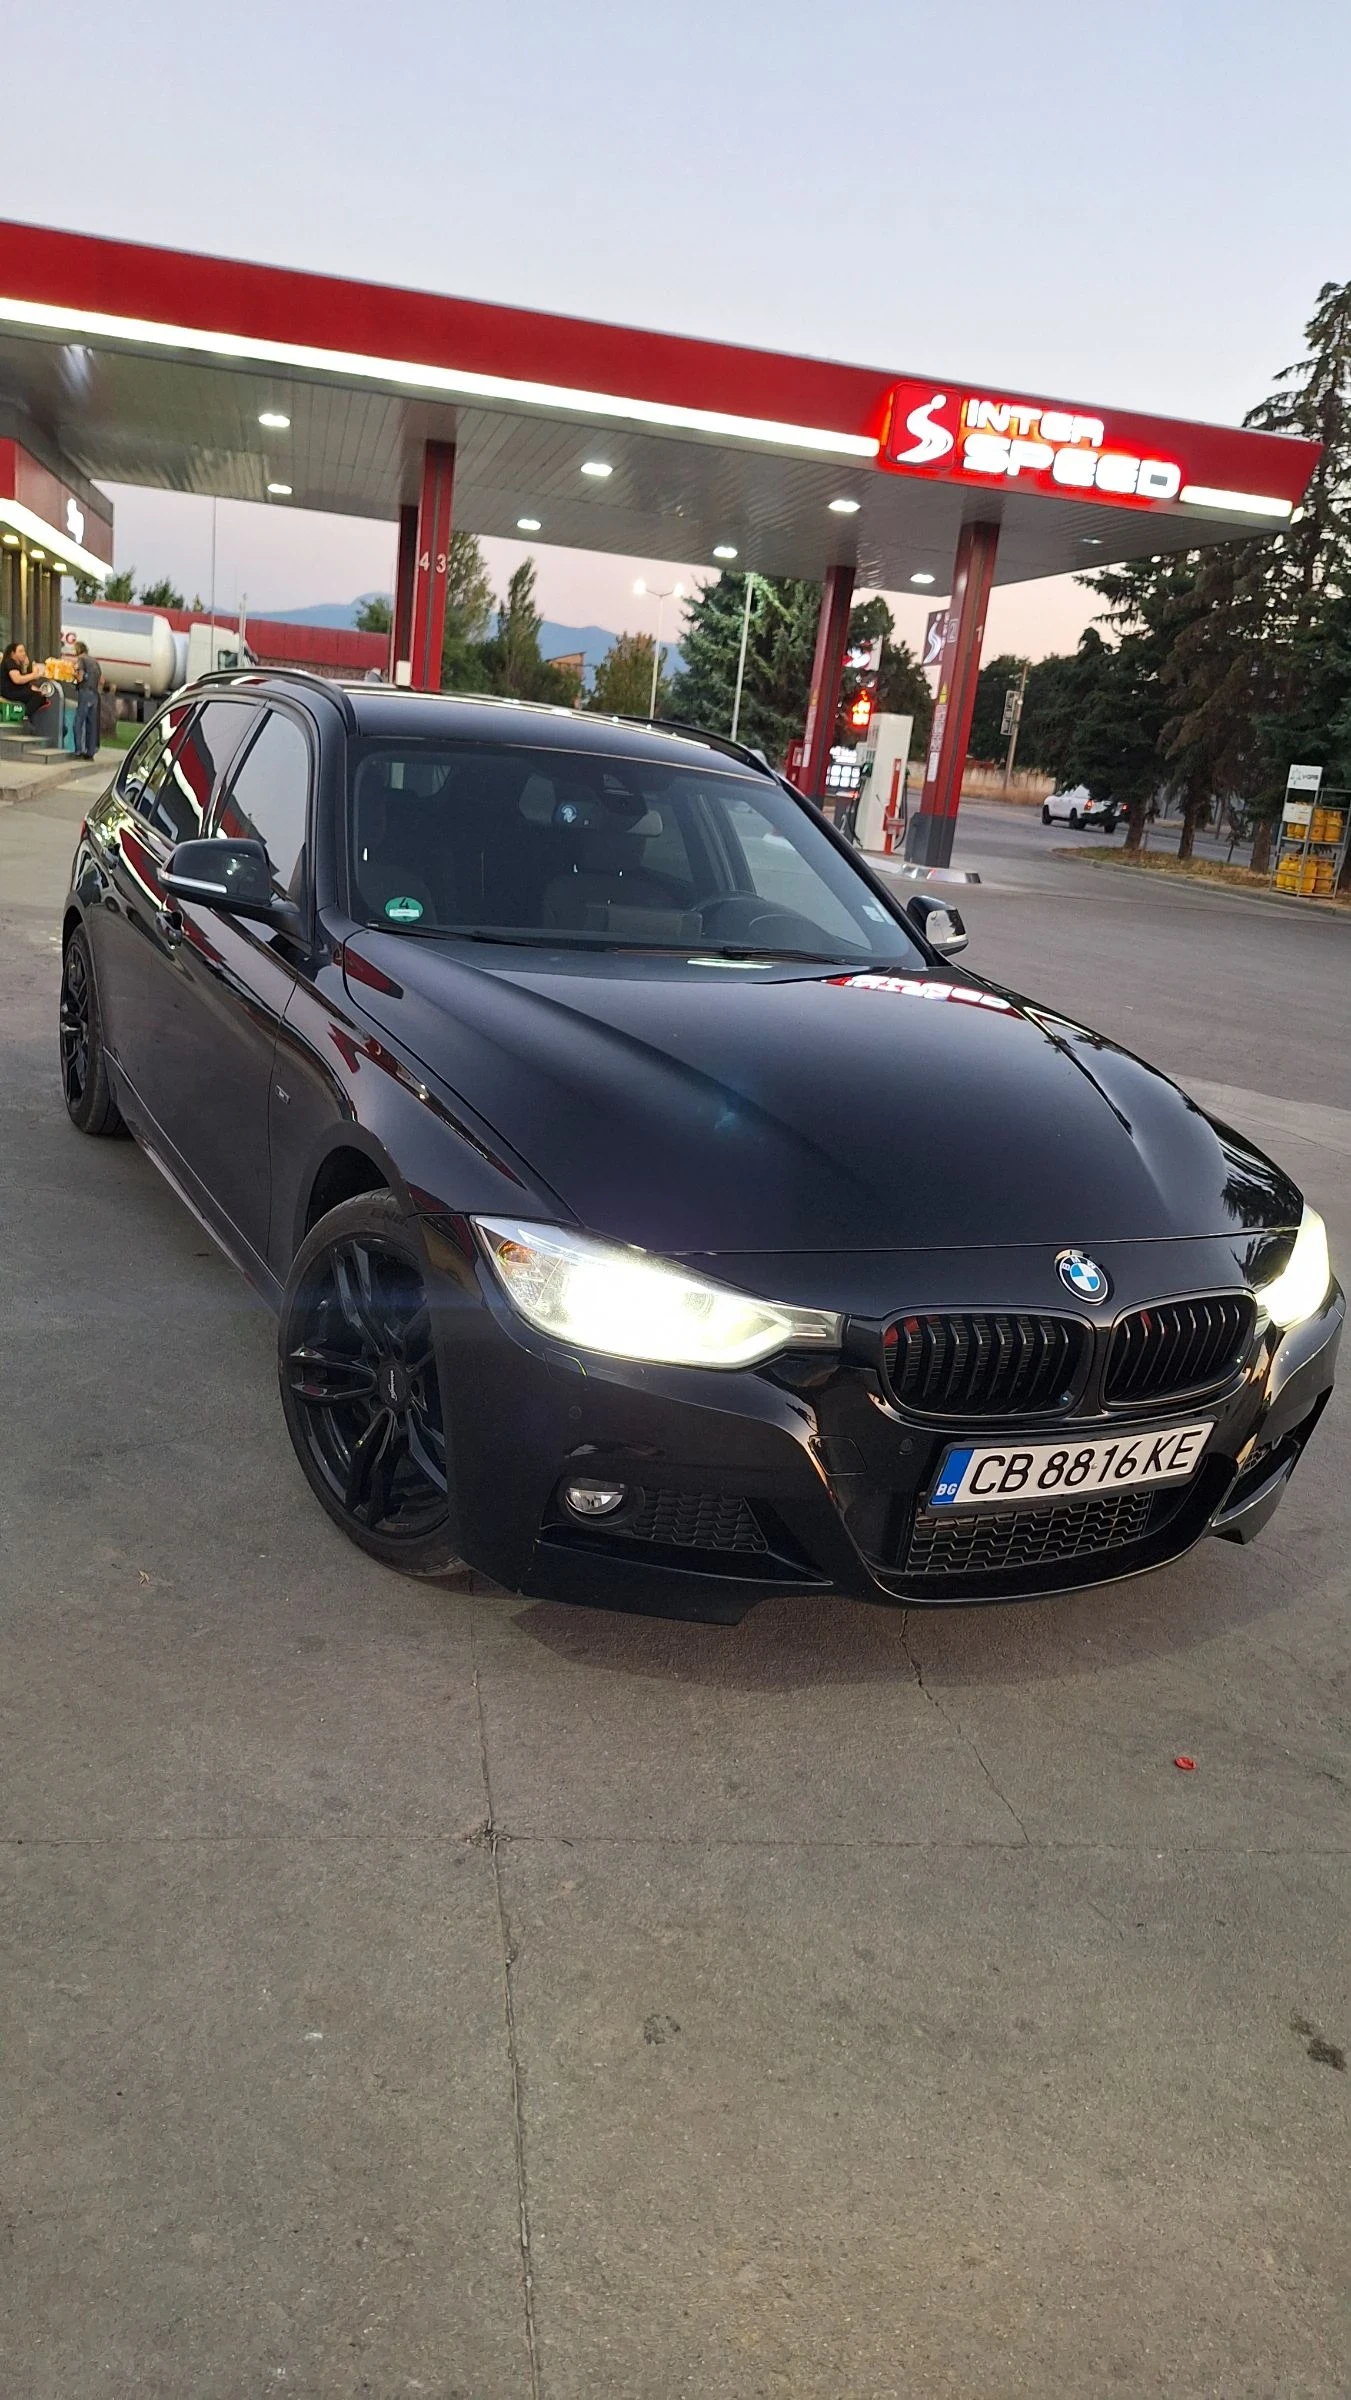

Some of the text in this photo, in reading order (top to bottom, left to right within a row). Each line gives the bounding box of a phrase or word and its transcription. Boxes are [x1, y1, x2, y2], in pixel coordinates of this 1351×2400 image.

[966, 398, 1105, 447] INTER
[963, 433, 1181, 499] SPEED
[419, 551, 430, 571] 4
[436, 553, 447, 573] 3
[975, 625, 984, 642] 1
[399, 897, 410, 909] 4
[1061, 1256, 1097, 1271] BMW
[969, 1429, 1204, 1494] CB 8816 KE
[936, 1483, 957, 1496] BG
